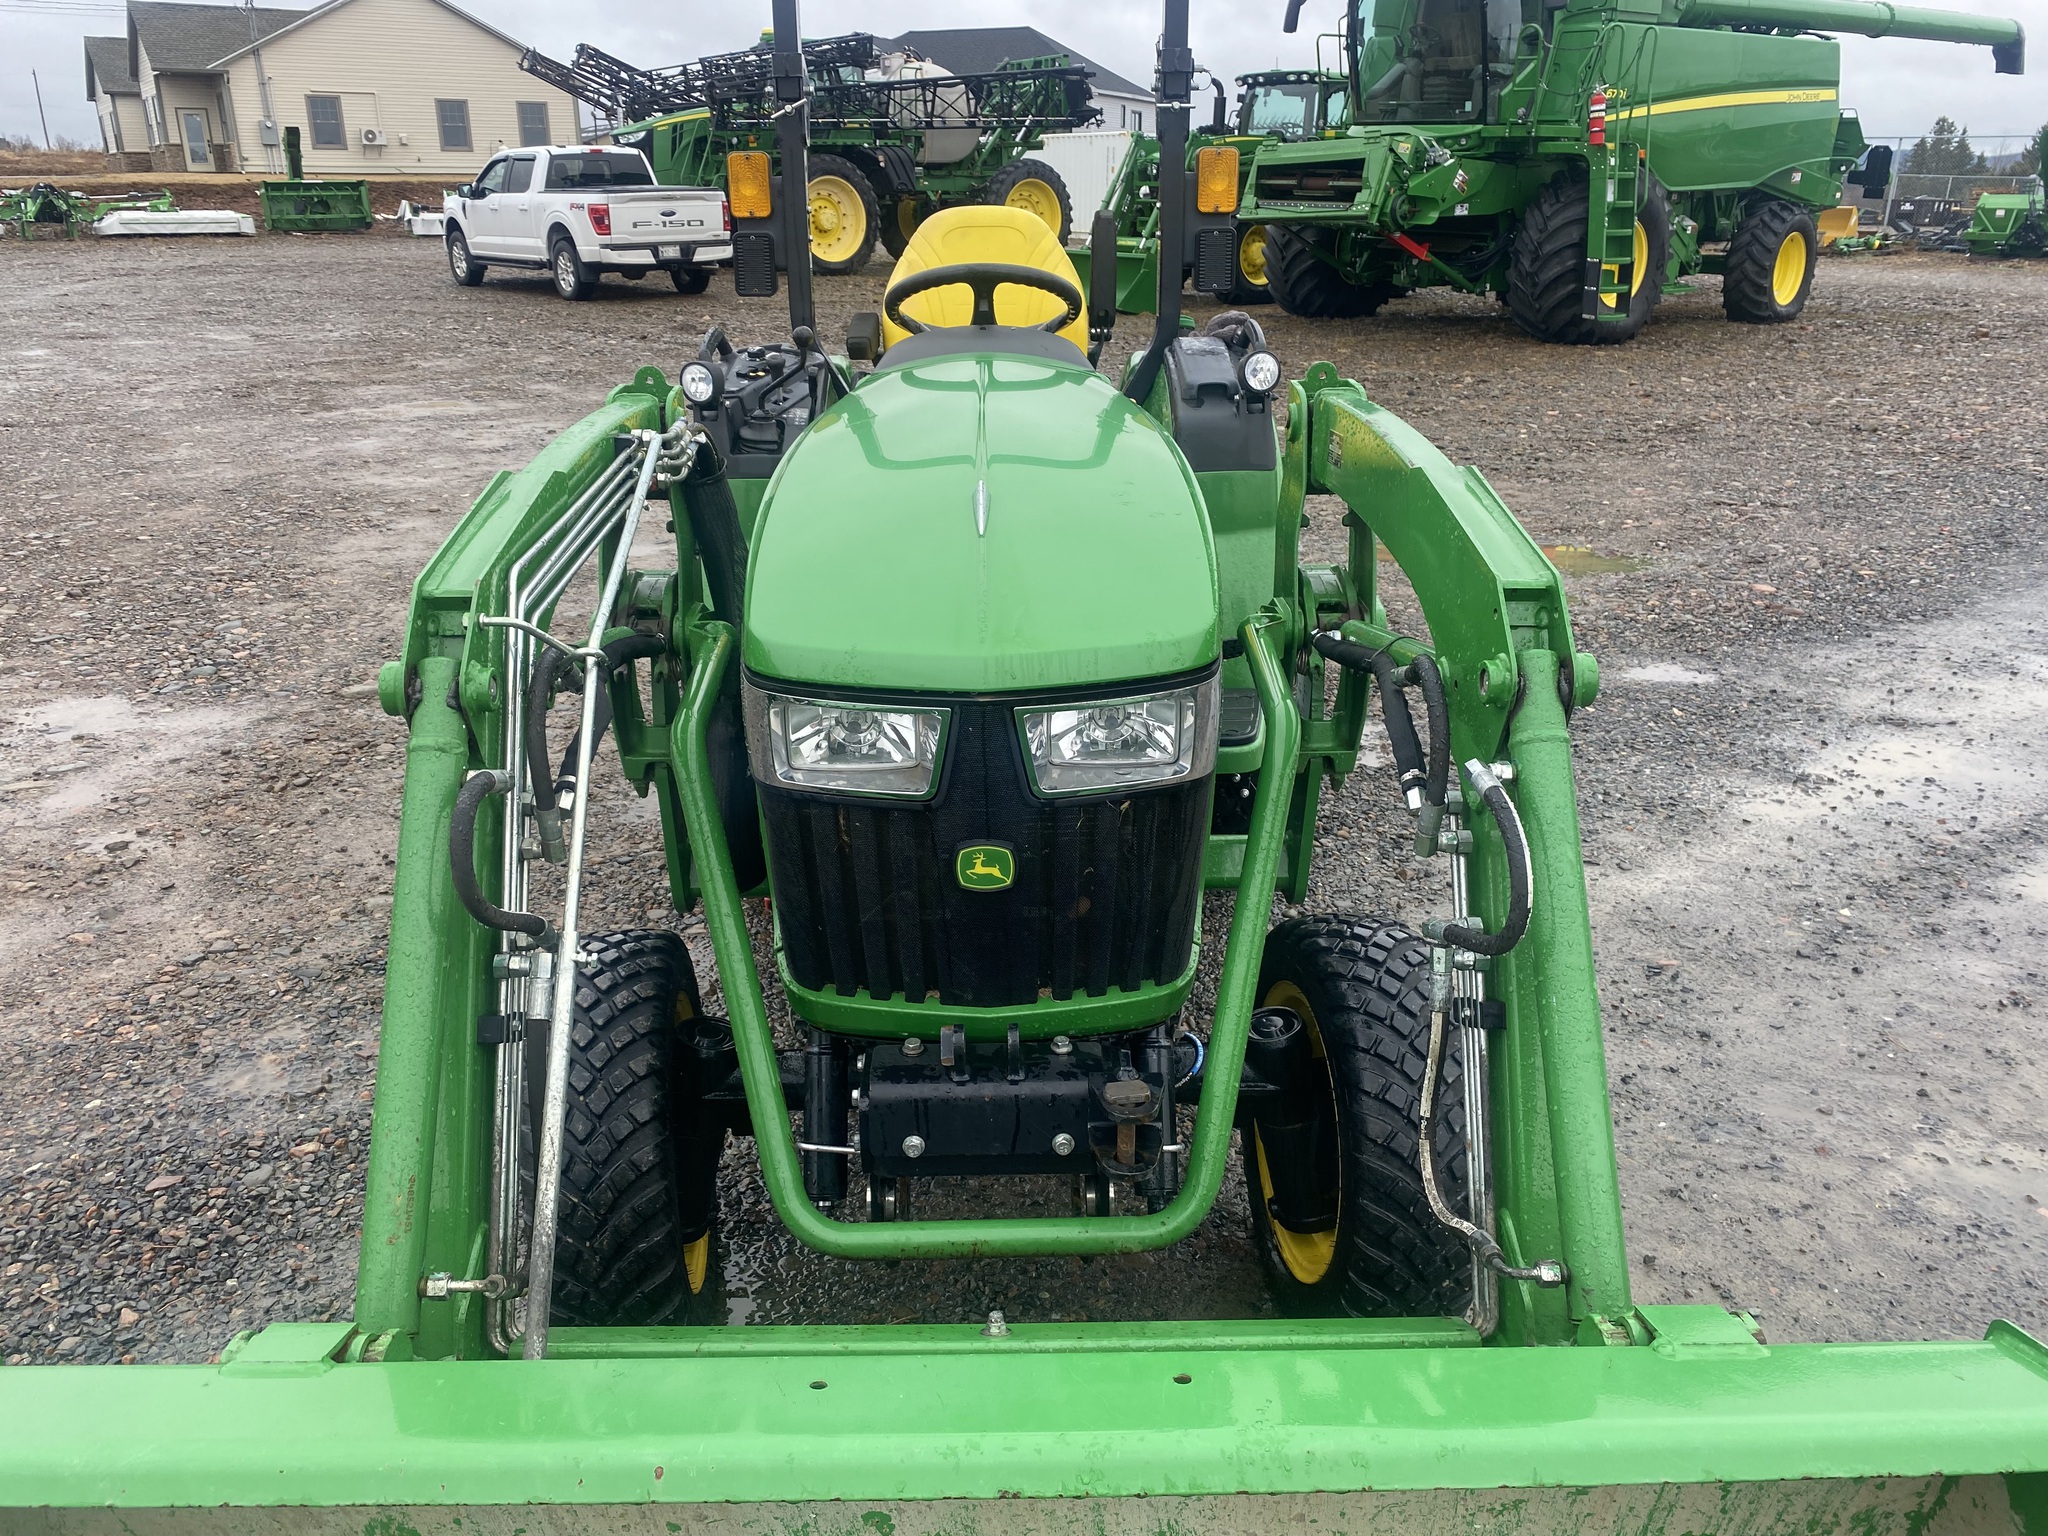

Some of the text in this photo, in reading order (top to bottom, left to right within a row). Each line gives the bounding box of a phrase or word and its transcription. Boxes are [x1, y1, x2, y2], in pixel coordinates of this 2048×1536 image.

[1786, 91, 1821, 102] JOHN DEERE
[632, 219, 704, 229] F-150
